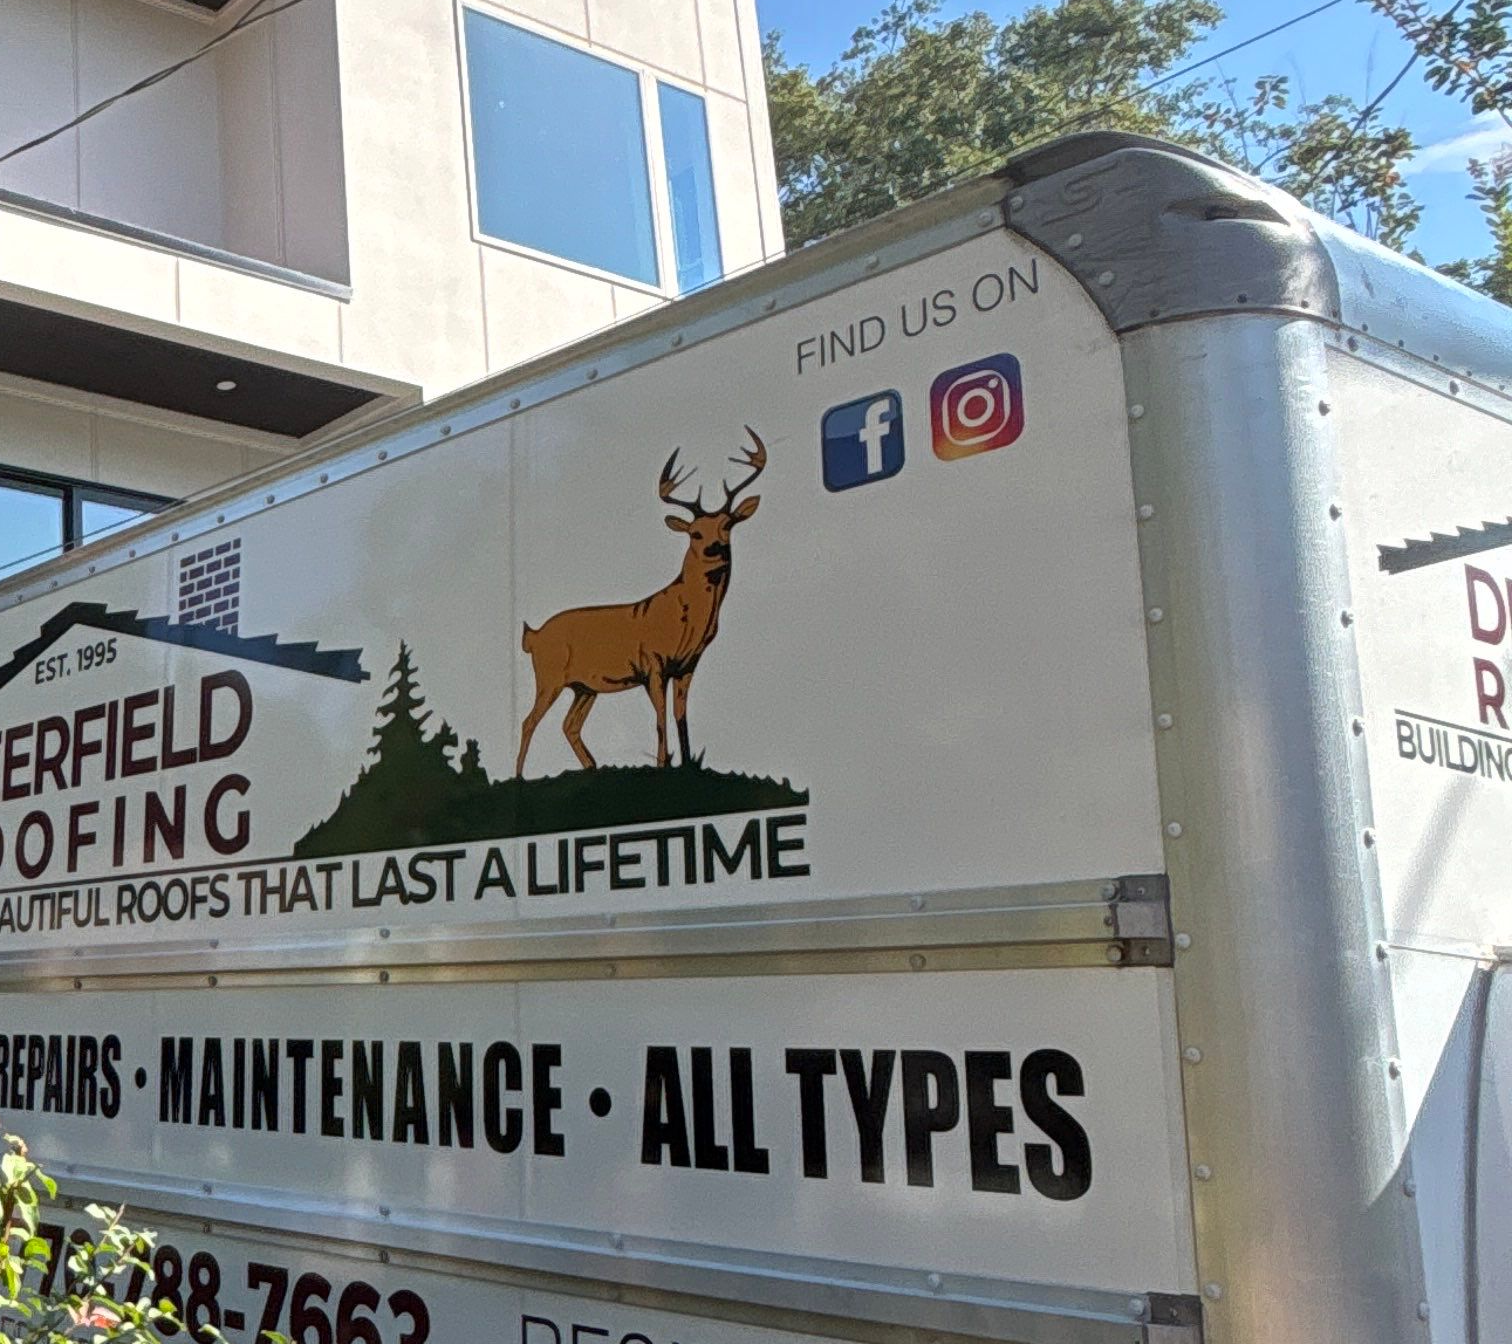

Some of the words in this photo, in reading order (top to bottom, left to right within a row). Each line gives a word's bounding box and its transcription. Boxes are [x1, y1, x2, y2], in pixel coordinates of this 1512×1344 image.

[796, 315, 887, 375] FIND
[901, 289, 958, 338] US
[972, 257, 1040, 312] ON
[1464, 562, 1512, 646] D
[34, 652, 71, 685] EST.
[77, 637, 118, 673] 1995
[115, 873, 232, 926] ROOFS
[237, 861, 343, 916] THAT
[351, 849, 467, 908] LAST
[473, 847, 517, 901] A
[527, 813, 812, 897] LIFETIME
[159, 1037, 566, 1158] MAINTENANCE
[640, 1045, 770, 1175] ALL
[784, 1046, 1093, 1202] TYPES
